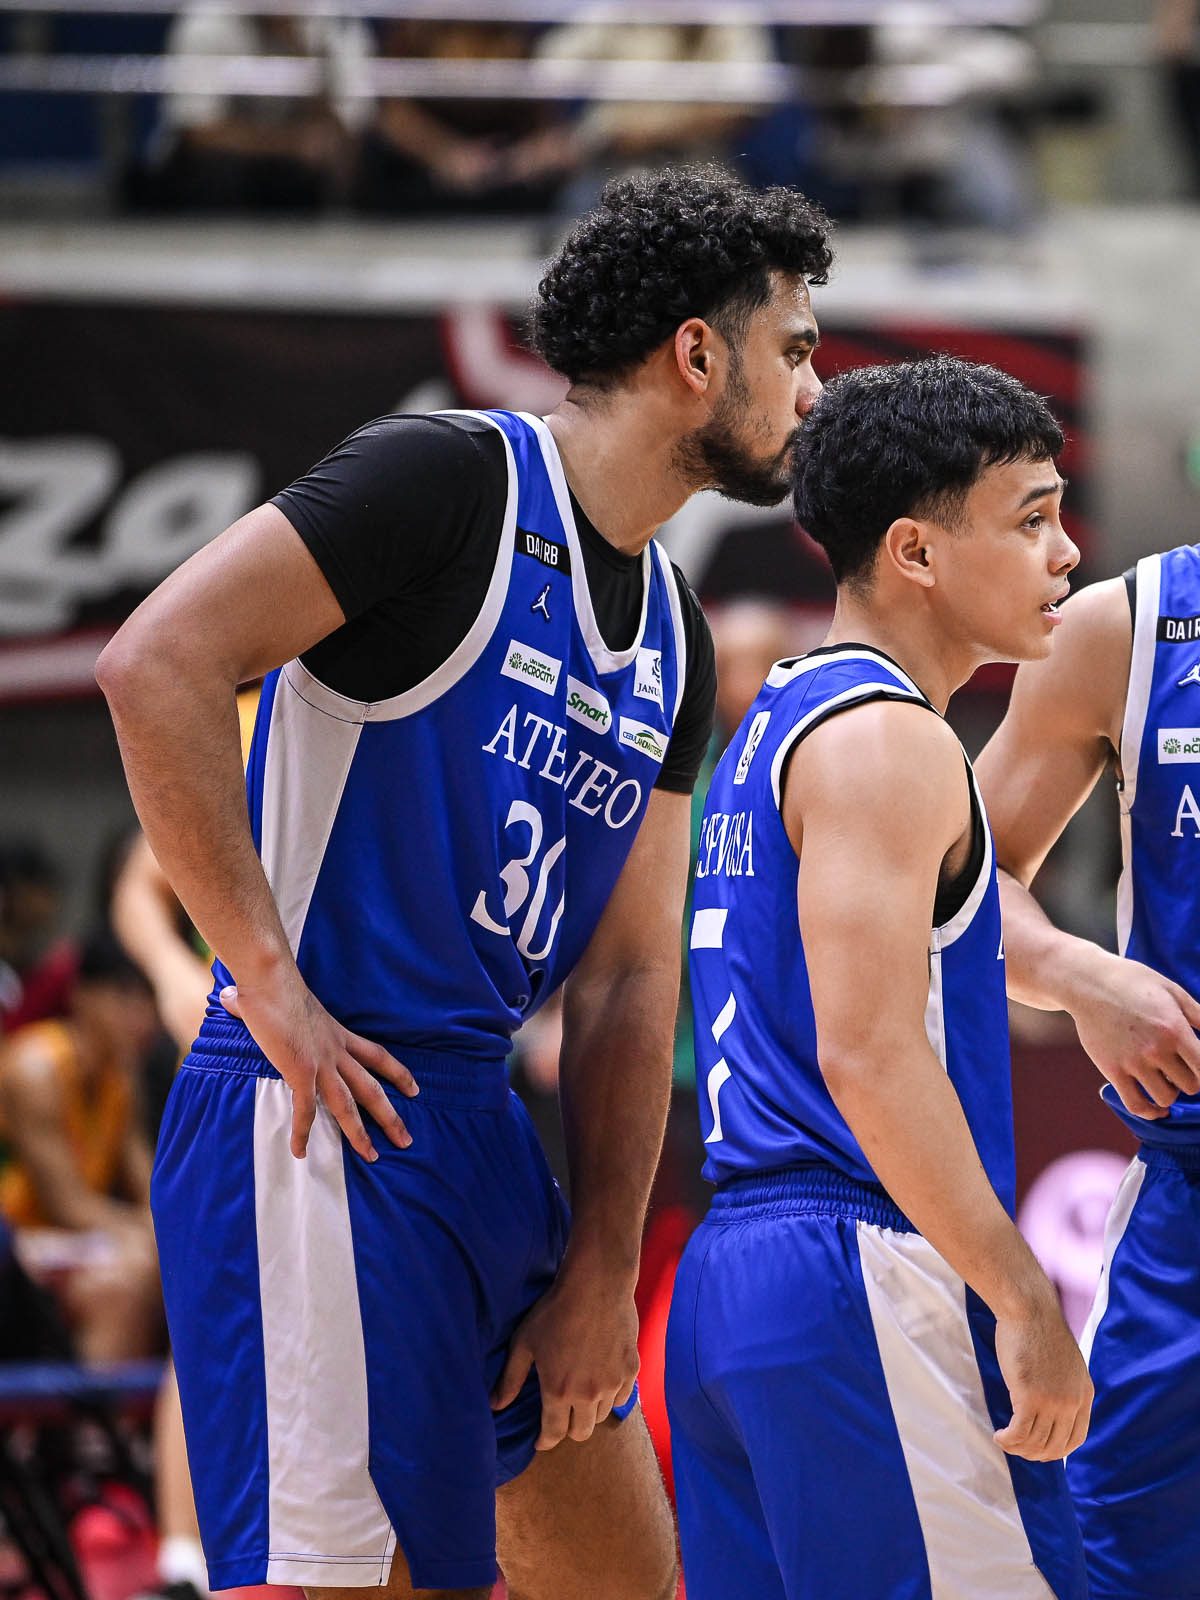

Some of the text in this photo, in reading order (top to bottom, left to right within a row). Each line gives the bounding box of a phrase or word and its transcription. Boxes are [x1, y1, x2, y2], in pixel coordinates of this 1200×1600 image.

[521, 662, 555, 685] ACROCITY
[567, 692, 609, 727] Smart
[470, 800, 566, 960] 30
